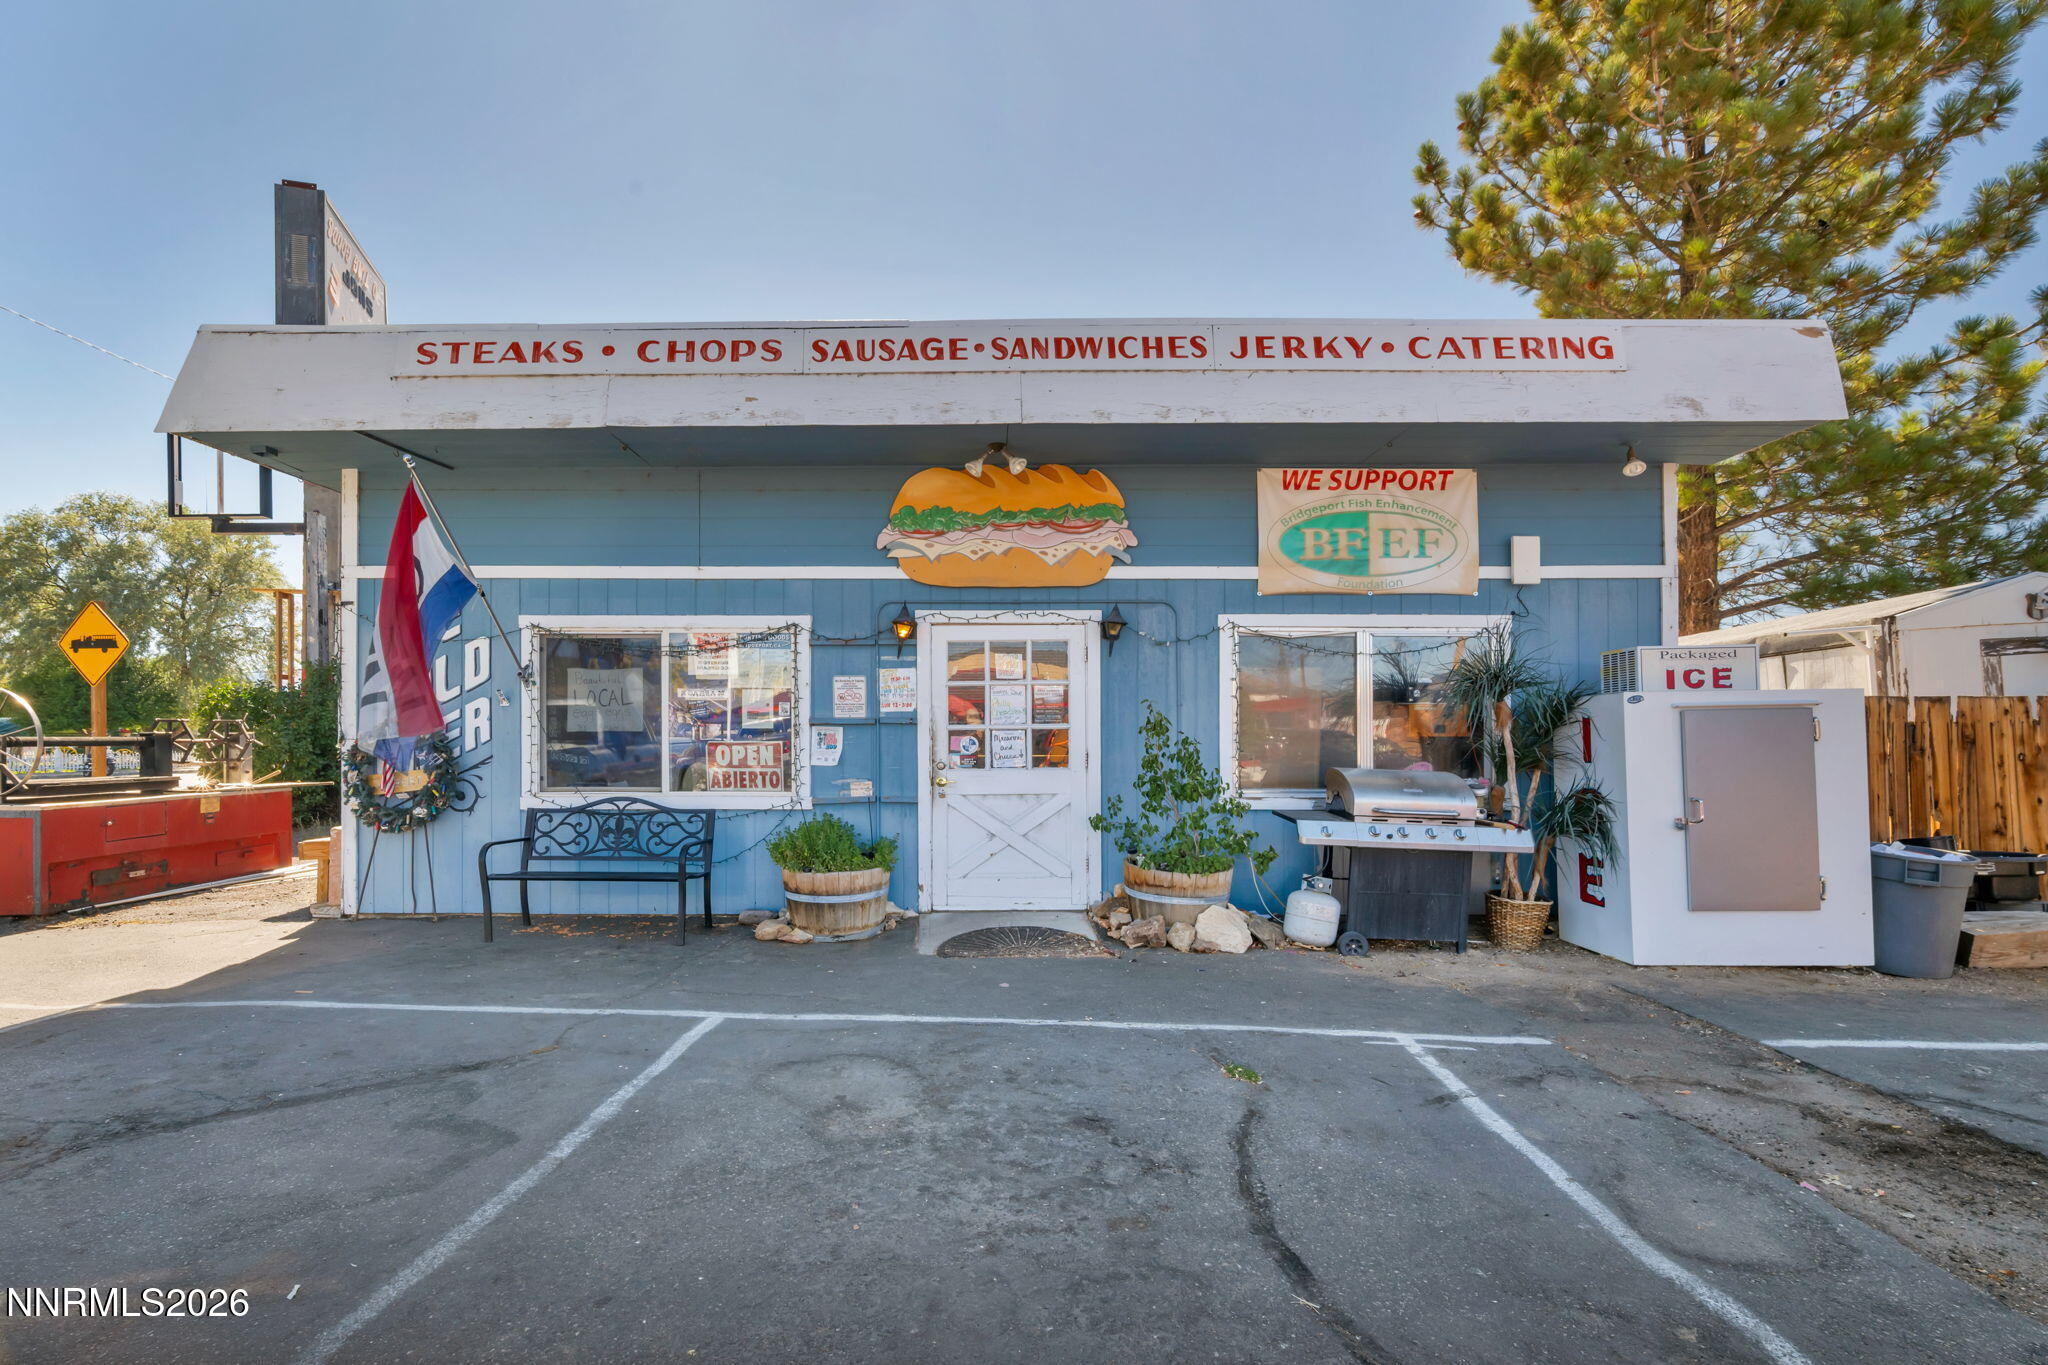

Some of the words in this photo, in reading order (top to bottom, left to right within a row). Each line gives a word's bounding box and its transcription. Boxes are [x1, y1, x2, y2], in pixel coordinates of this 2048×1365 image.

[416, 340, 583, 365] STEAKS
[637, 339, 783, 363] CHOPS
[811, 337, 969, 362] SAUSAGE
[990, 335, 1208, 361] SANDWICHES
[1229, 335, 1372, 360] JERKY
[1407, 335, 1616, 360] CATERING
[1281, 469, 1326, 491] WE
[1327, 469, 1454, 491] SUPPORT
[1280, 500, 1345, 528] Bridgeport
[1348, 498, 1373, 508] Fish
[1375, 498, 1459, 530] Enhancement
[1337, 577, 1404, 590] Foundation
[1660, 649, 1737, 661] Packaged
[1665, 667, 1732, 690] ICE
[715, 744, 774, 766] OPEN
[710, 770, 781, 789] ABIERTO
